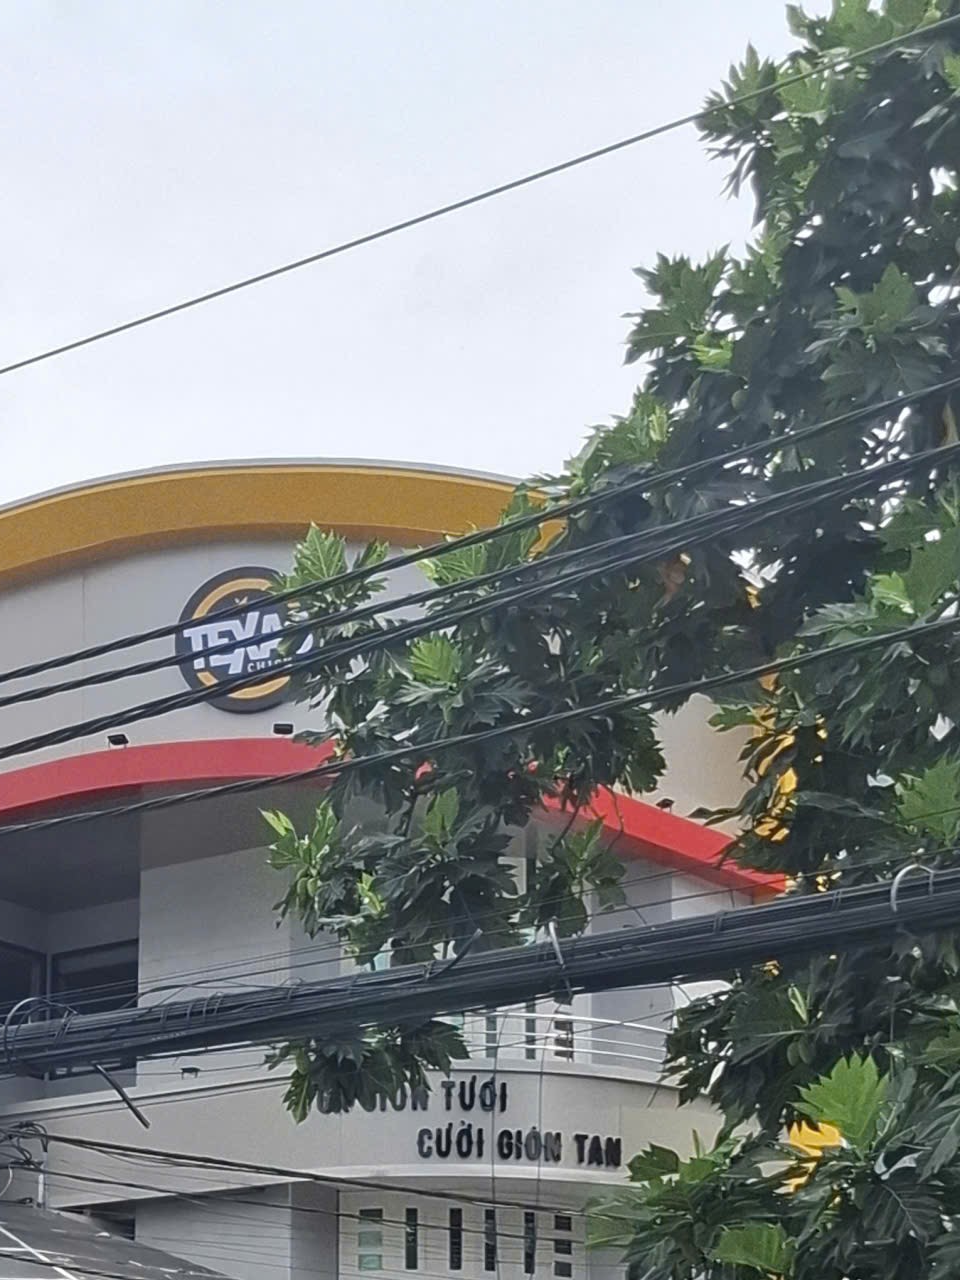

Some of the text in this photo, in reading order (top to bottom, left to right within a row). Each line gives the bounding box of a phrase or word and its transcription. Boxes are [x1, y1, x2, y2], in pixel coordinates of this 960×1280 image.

[183, 607, 313, 675] TEXA
[441, 1075, 507, 1112] TƯƠI
[574, 1133, 622, 1167] TAN
